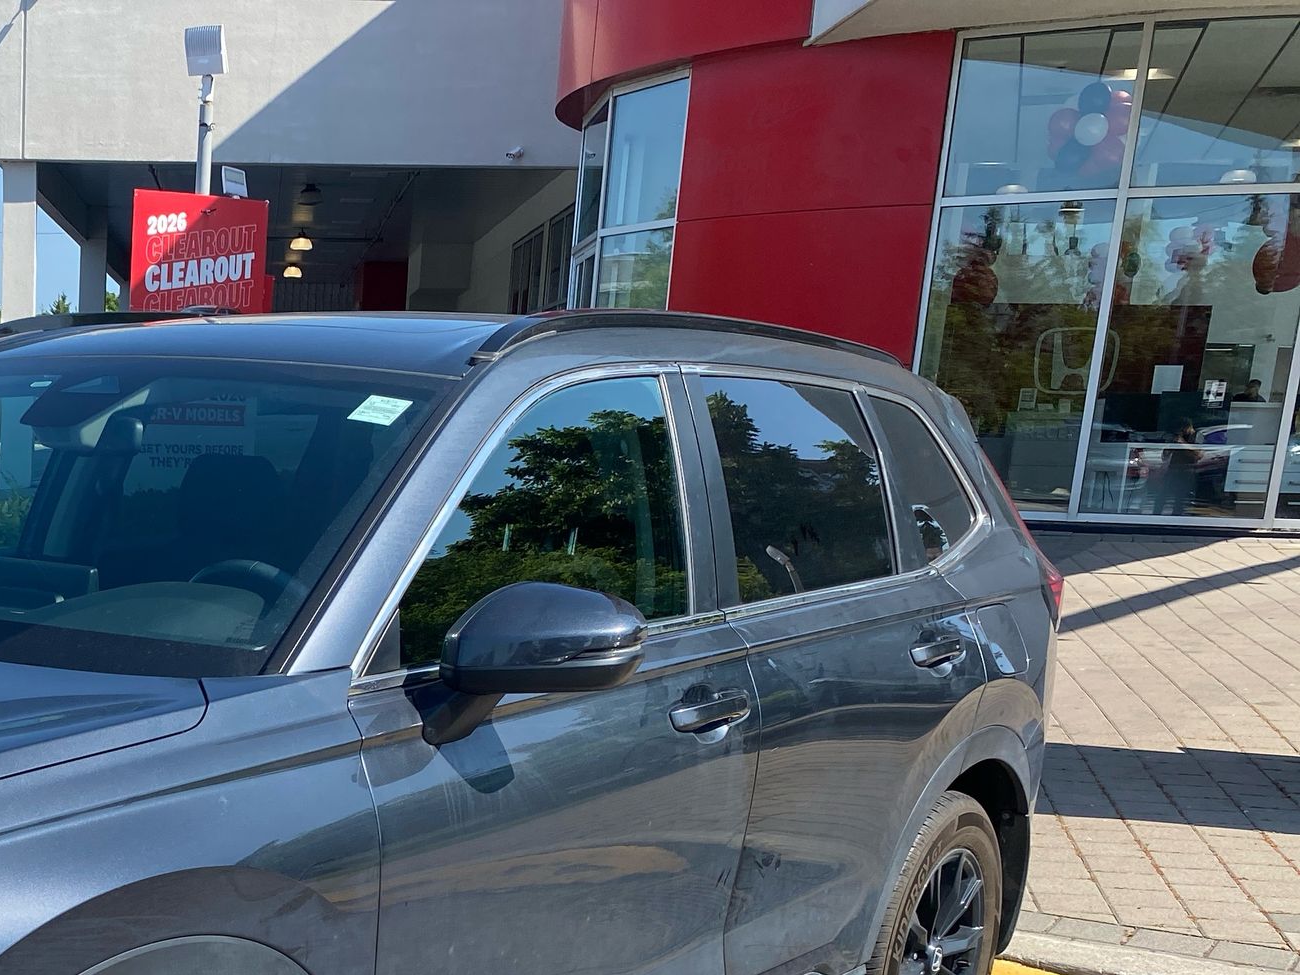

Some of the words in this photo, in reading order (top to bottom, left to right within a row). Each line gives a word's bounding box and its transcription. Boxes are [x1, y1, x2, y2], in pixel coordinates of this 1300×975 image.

[147, 211, 188, 236] 2026
[145, 224, 257, 264] CLEAROUT
[144, 252, 256, 293] CLEAROUT
[142, 279, 254, 313] CLEAROUT
[185, 406, 241, 422] MODELS
[164, 443, 204, 455] YOURS
